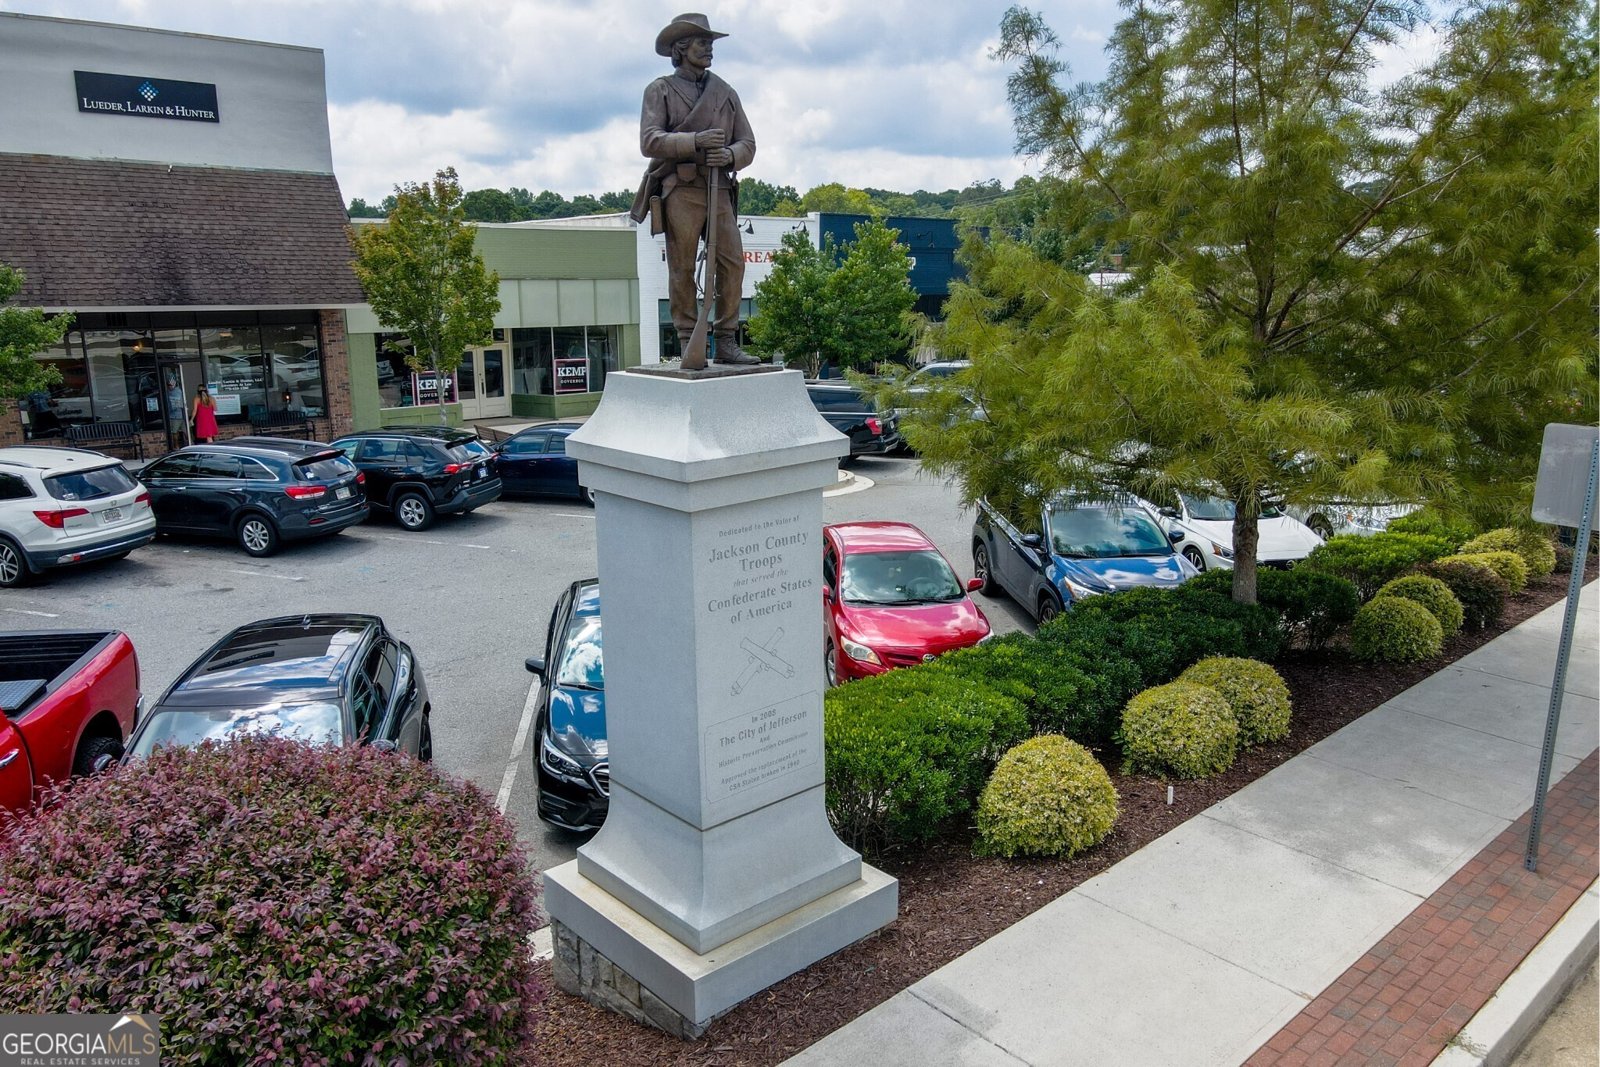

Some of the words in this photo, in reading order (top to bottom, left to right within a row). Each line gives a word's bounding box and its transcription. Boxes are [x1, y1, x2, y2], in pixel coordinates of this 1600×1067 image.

[83, 97, 126, 112] LUEDER,
[127, 101, 164, 114] LARKIN
[165, 107, 175, 115] &
[175, 105, 215, 119] HUNTER
[719, 525, 753, 537] Dedicated
[754, 523, 761, 531] to
[763, 520, 773, 528] the
[776, 517, 790, 526] Valor
[708, 543, 760, 563] Jackson
[765, 532, 809, 550] County
[739, 553, 783, 572] Troops
[733, 578, 749, 588] that
[751, 570, 775, 584] served
[777, 568, 788, 577] the
[708, 587, 777, 612] Confederate
[780, 578, 812, 594] States
[730, 610, 742, 624] of
[746, 600, 792, 620] America
[719, 736, 735, 747] The
[738, 728, 756, 741] City
[758, 723, 767, 734] of
[769, 711, 807, 730] Jefferson
[760, 735, 770, 743] And
[718, 755, 741, 769] Historic
[742, 743, 777, 759] Preservation
[721, 770, 747, 785] Approved
[758, 753, 791, 773] replacement
